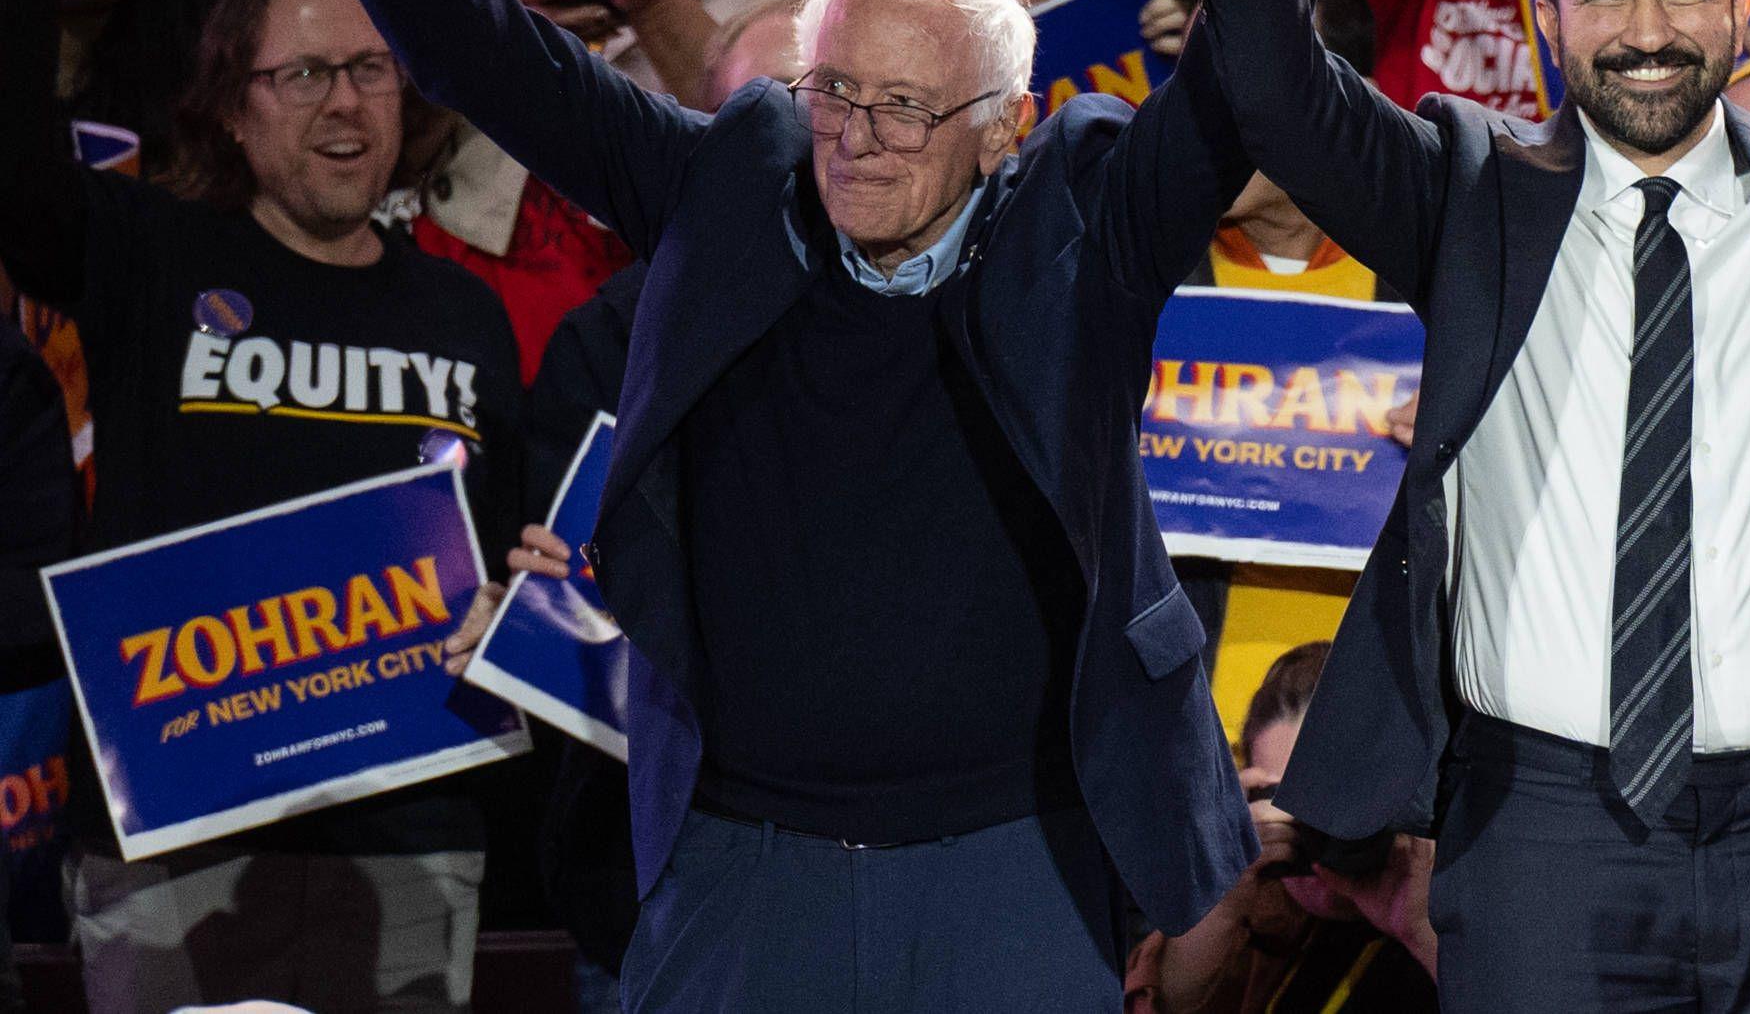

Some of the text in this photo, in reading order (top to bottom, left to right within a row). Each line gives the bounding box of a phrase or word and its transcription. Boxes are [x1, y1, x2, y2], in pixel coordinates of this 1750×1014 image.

[180, 330, 477, 429] EQUITY!
[1142, 359, 1400, 438] HRAN
[1192, 436, 1287, 468] YORK
[1293, 443, 1375, 473] CITY
[120, 555, 452, 708] ZOHRAN
[159, 636, 447, 745] FOR NEW YORK CITY
